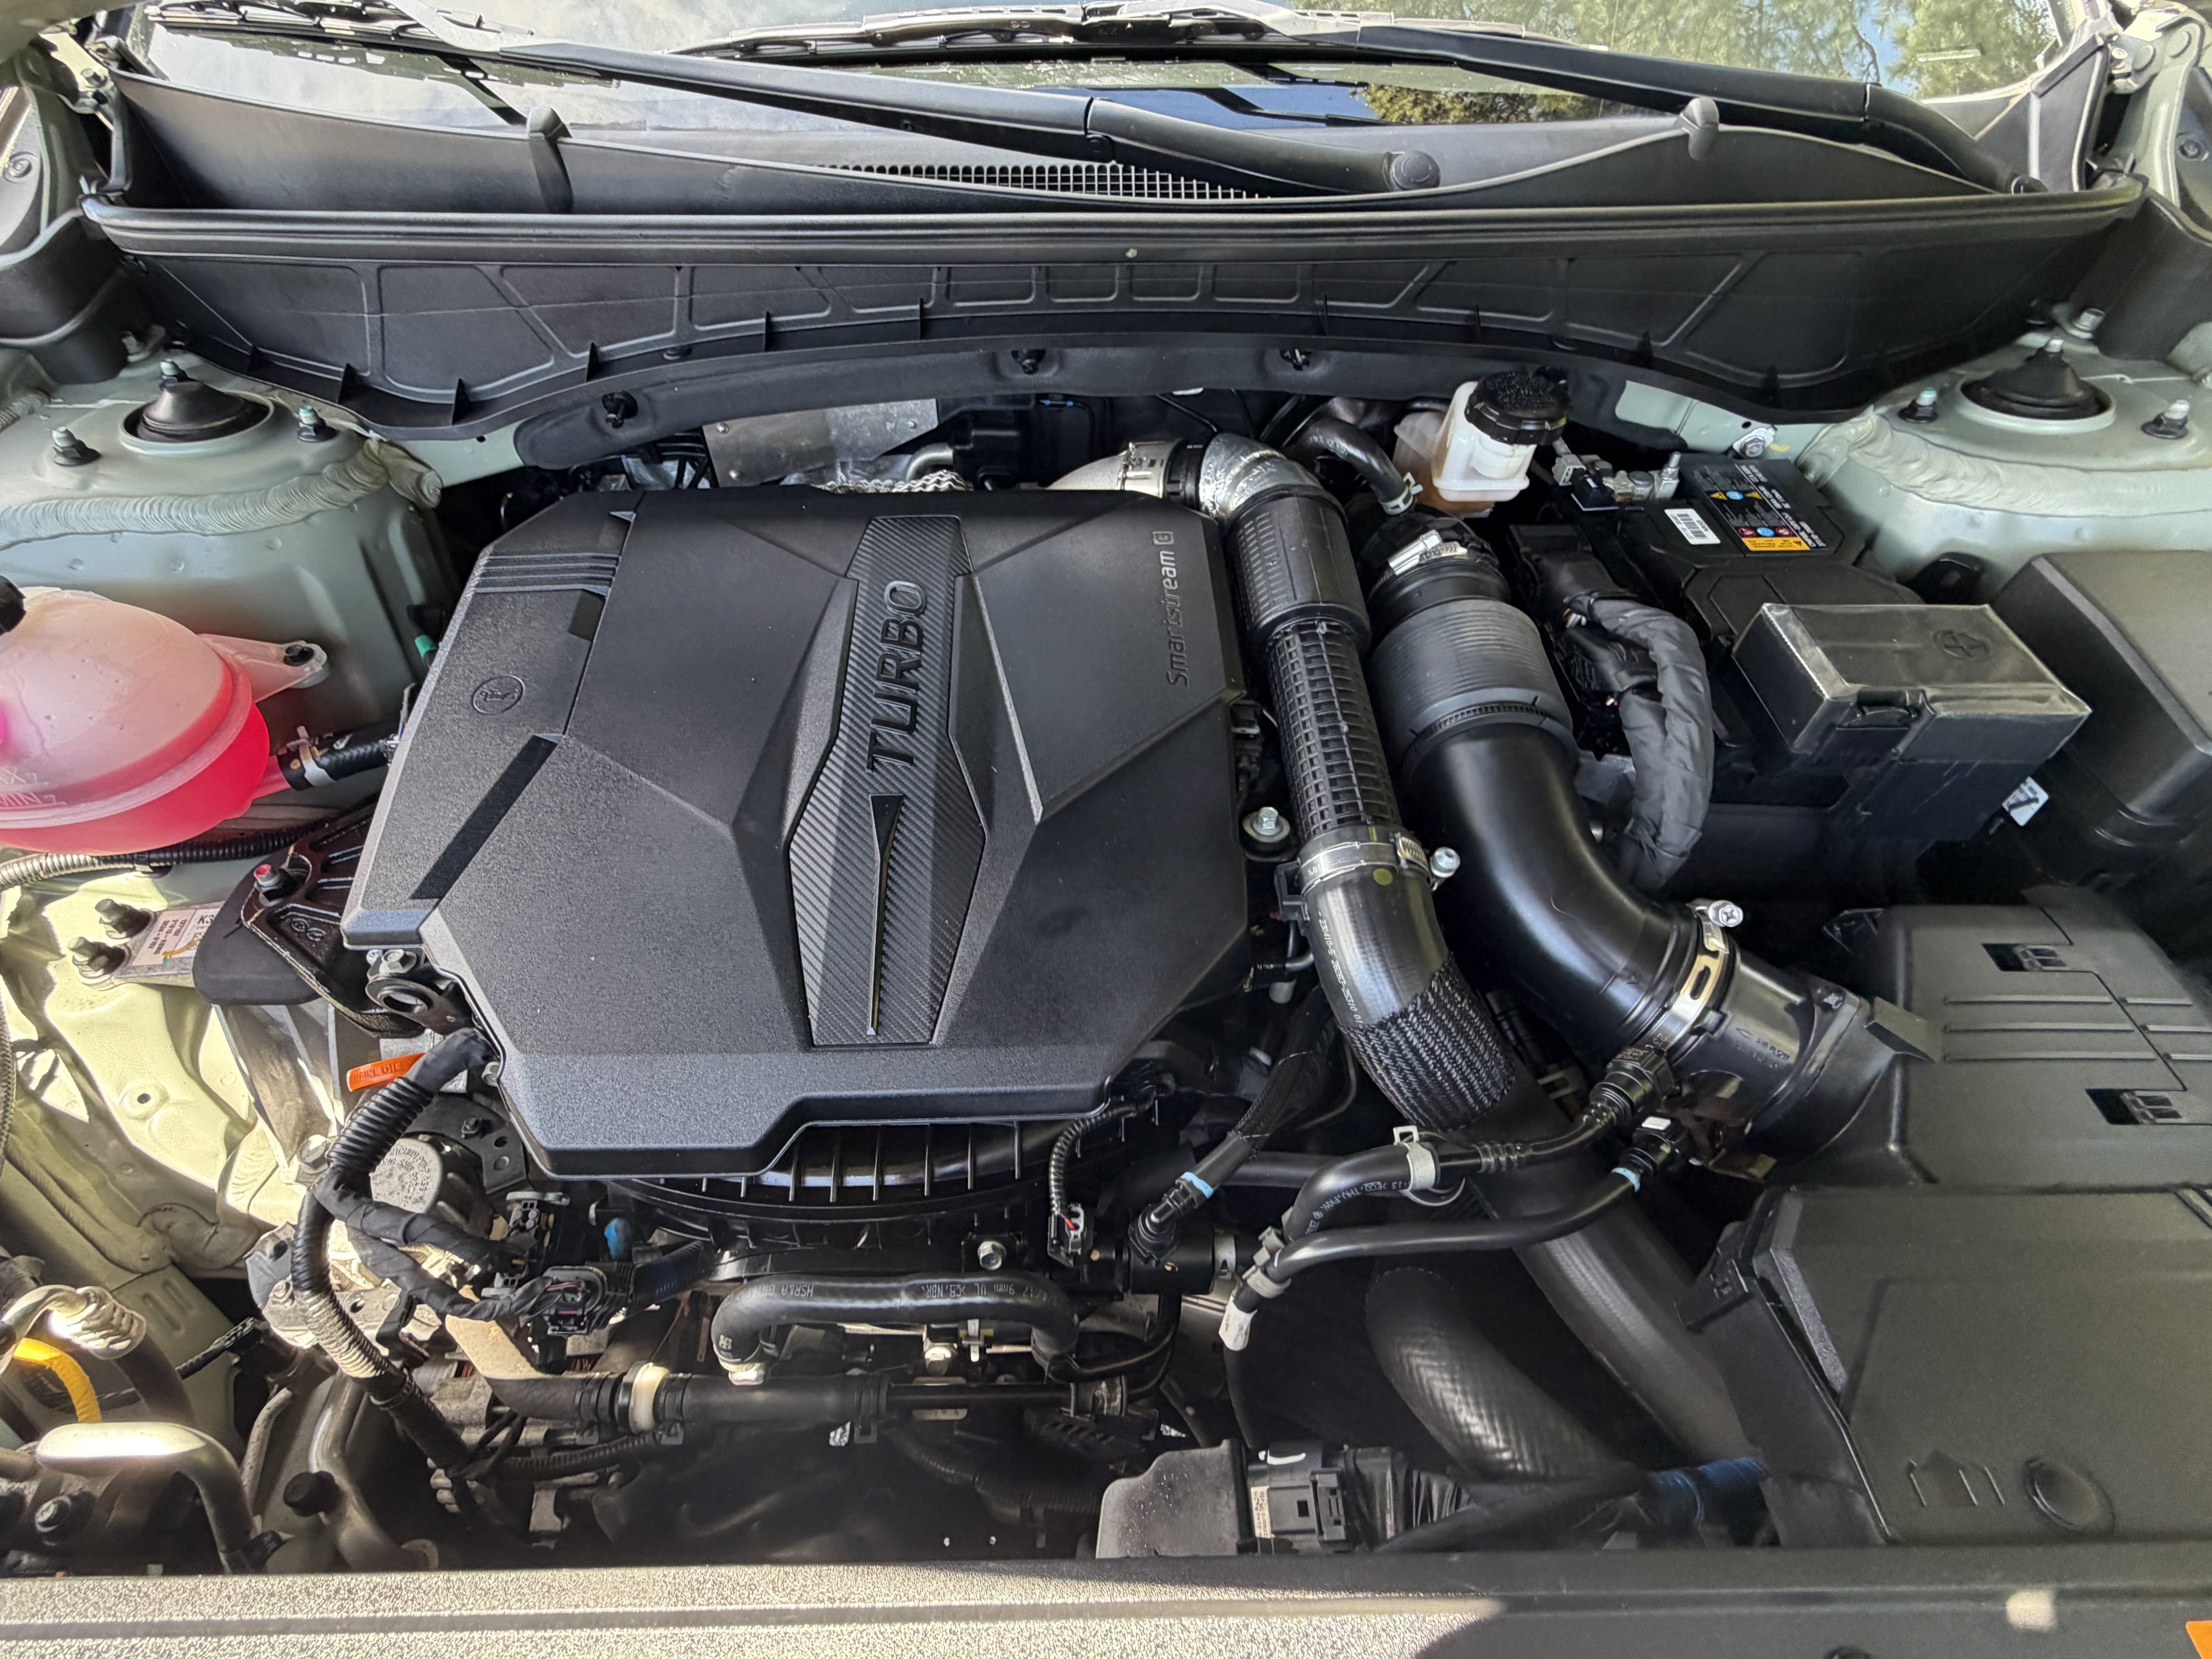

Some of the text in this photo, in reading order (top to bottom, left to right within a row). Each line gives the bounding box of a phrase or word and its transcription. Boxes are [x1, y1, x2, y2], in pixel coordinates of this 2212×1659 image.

[1160, 550, 1189, 686] Smartstream
[866, 580, 927, 773] TURBO
[781, 1283, 814, 1297] HSR&A
[974, 1283, 986, 1296] UL
[993, 1283, 1014, 1295] 9mm
